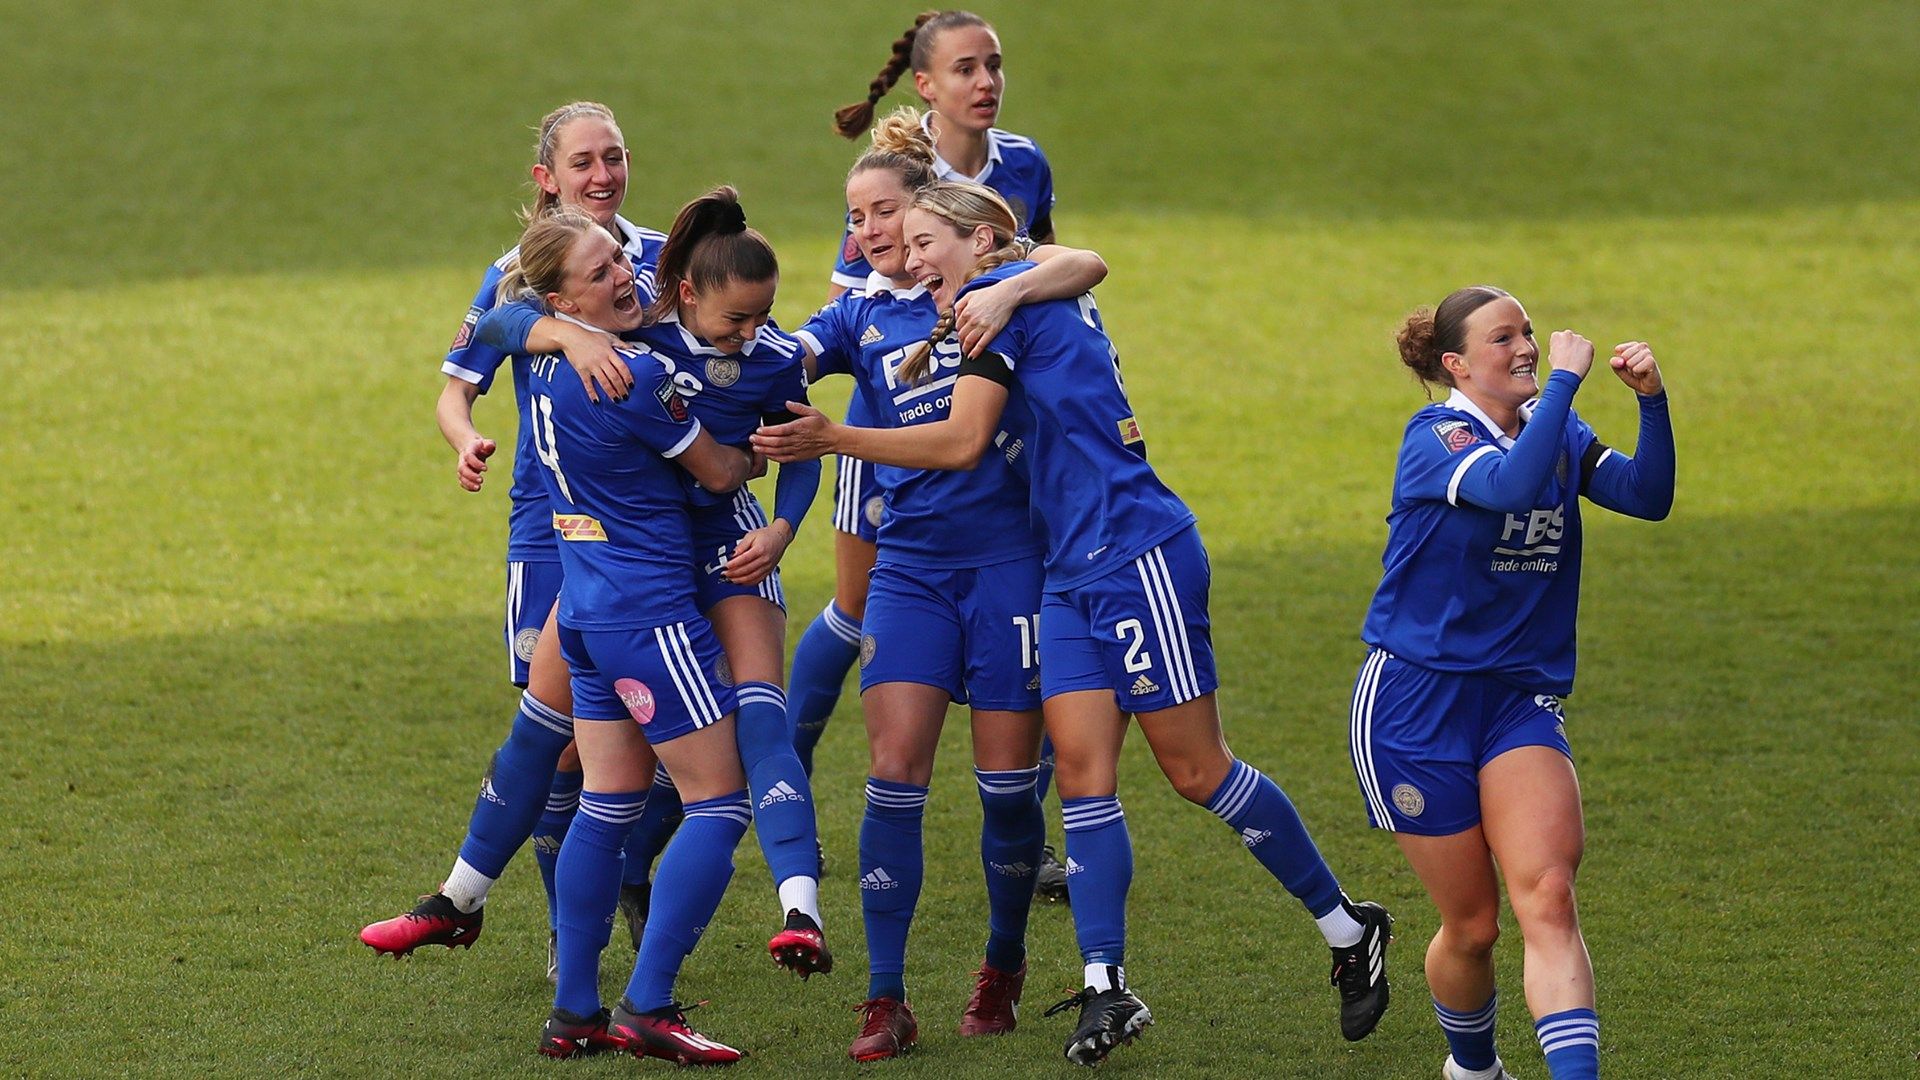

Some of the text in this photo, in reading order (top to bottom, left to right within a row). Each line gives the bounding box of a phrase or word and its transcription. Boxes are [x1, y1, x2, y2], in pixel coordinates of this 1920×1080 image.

[899, 402, 933, 424] trade
[530, 393, 574, 506] 4
[1490, 558, 1558, 572] trade online
[1115, 618, 1153, 674] 2
[759, 793, 805, 809] adidas
